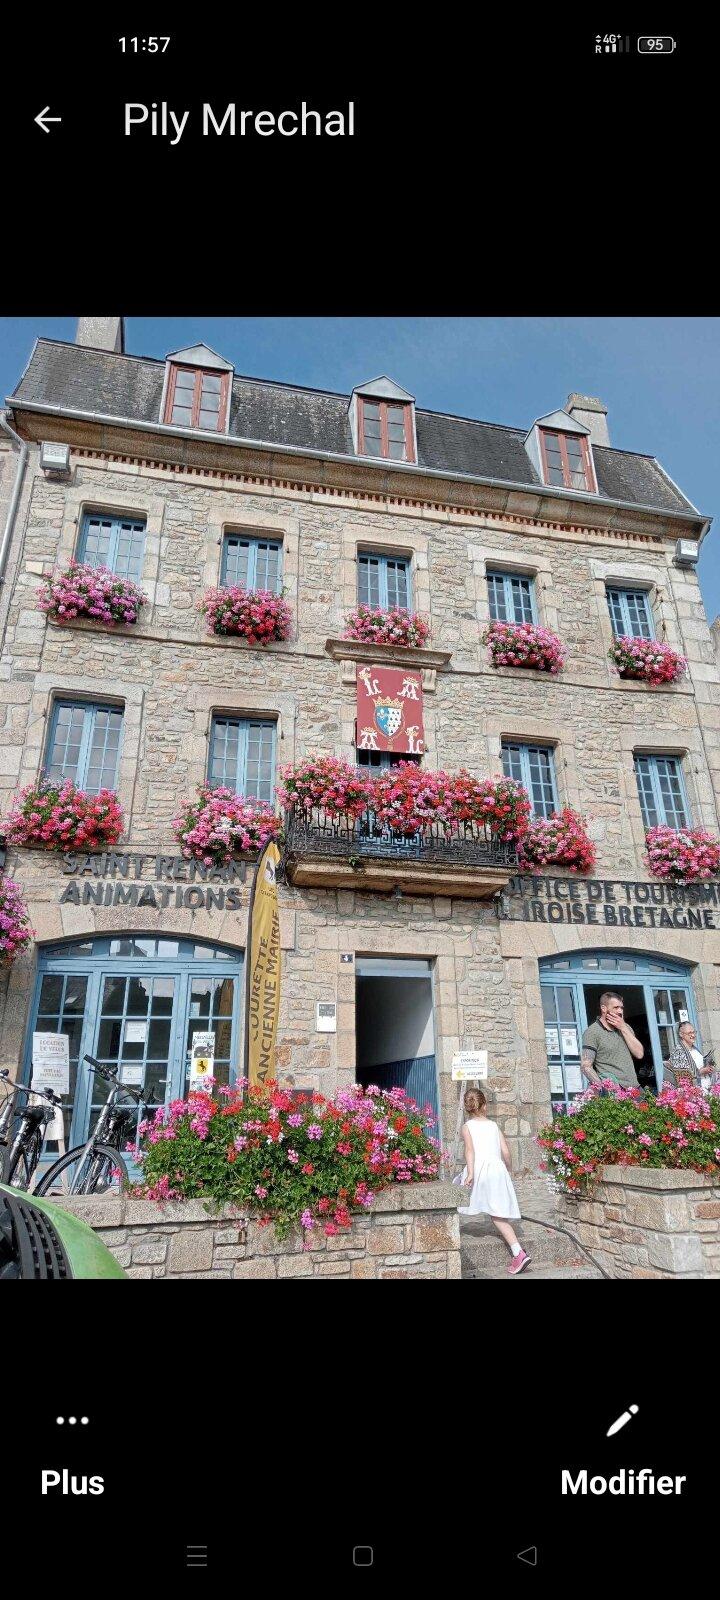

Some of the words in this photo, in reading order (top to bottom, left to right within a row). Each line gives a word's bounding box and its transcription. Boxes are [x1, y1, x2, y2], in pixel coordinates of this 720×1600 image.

[60, 852, 145, 879] SAINT
[154, 855, 246, 884] RENAN
[59, 881, 242, 910] ANIMATIONS
[586, 880, 616, 902] DE
[620, 882, 720, 906] TOURISM
[522, 900, 599, 924] IROISE
[604, 904, 716, 929] BRETAGNE
[265, 909, 281, 976] MAIRIE
[257, 979, 277, 1084] ANCIENNE
